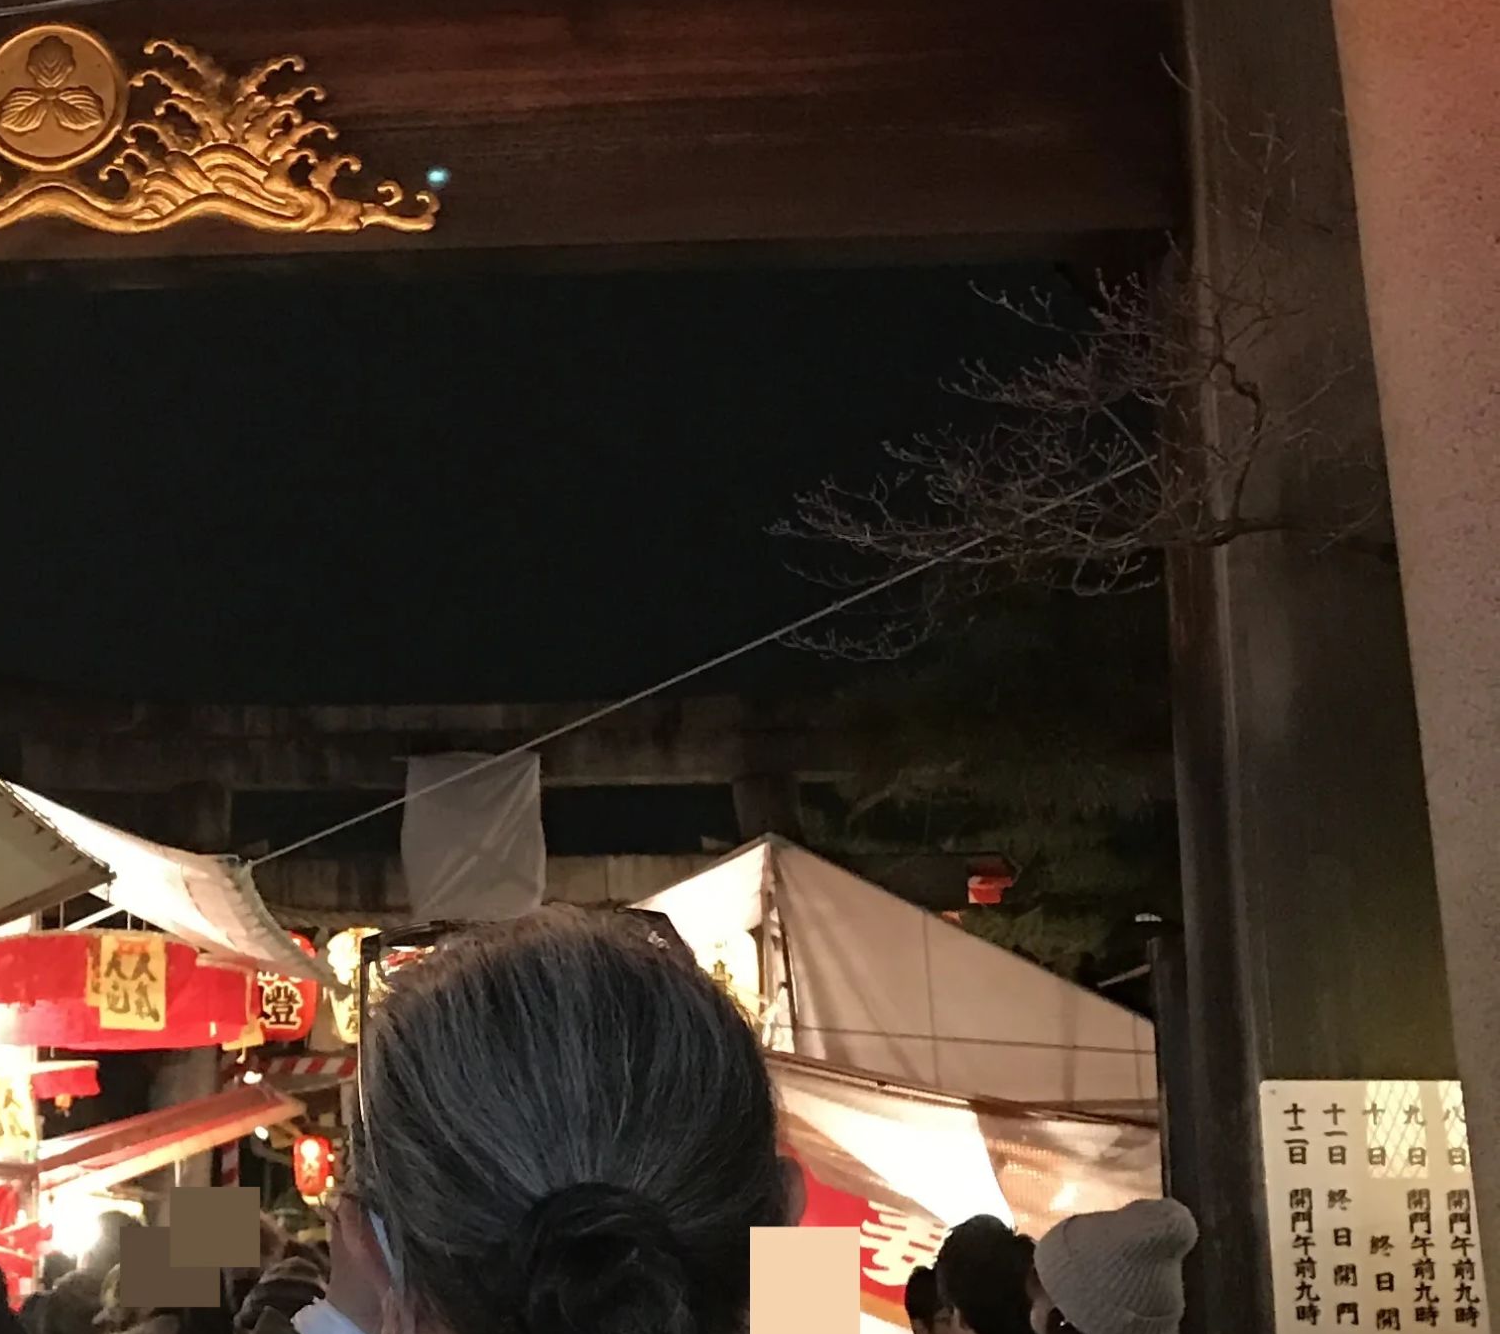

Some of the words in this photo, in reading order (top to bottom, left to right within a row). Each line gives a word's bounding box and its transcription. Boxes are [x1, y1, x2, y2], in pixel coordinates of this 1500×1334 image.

[1283, 1102, 1310, 1165] 十二日
[1322, 1102, 1348, 1165] 十一日
[1362, 1102, 1387, 1167] 十日
[1403, 1104, 1427, 1167] 九日
[1289, 1187, 1321, 1326] 開門午前九時
[1406, 1187, 1440, 1328] 開門午前九時
[1446, 1188, 1481, 1328] 開門午前九時
